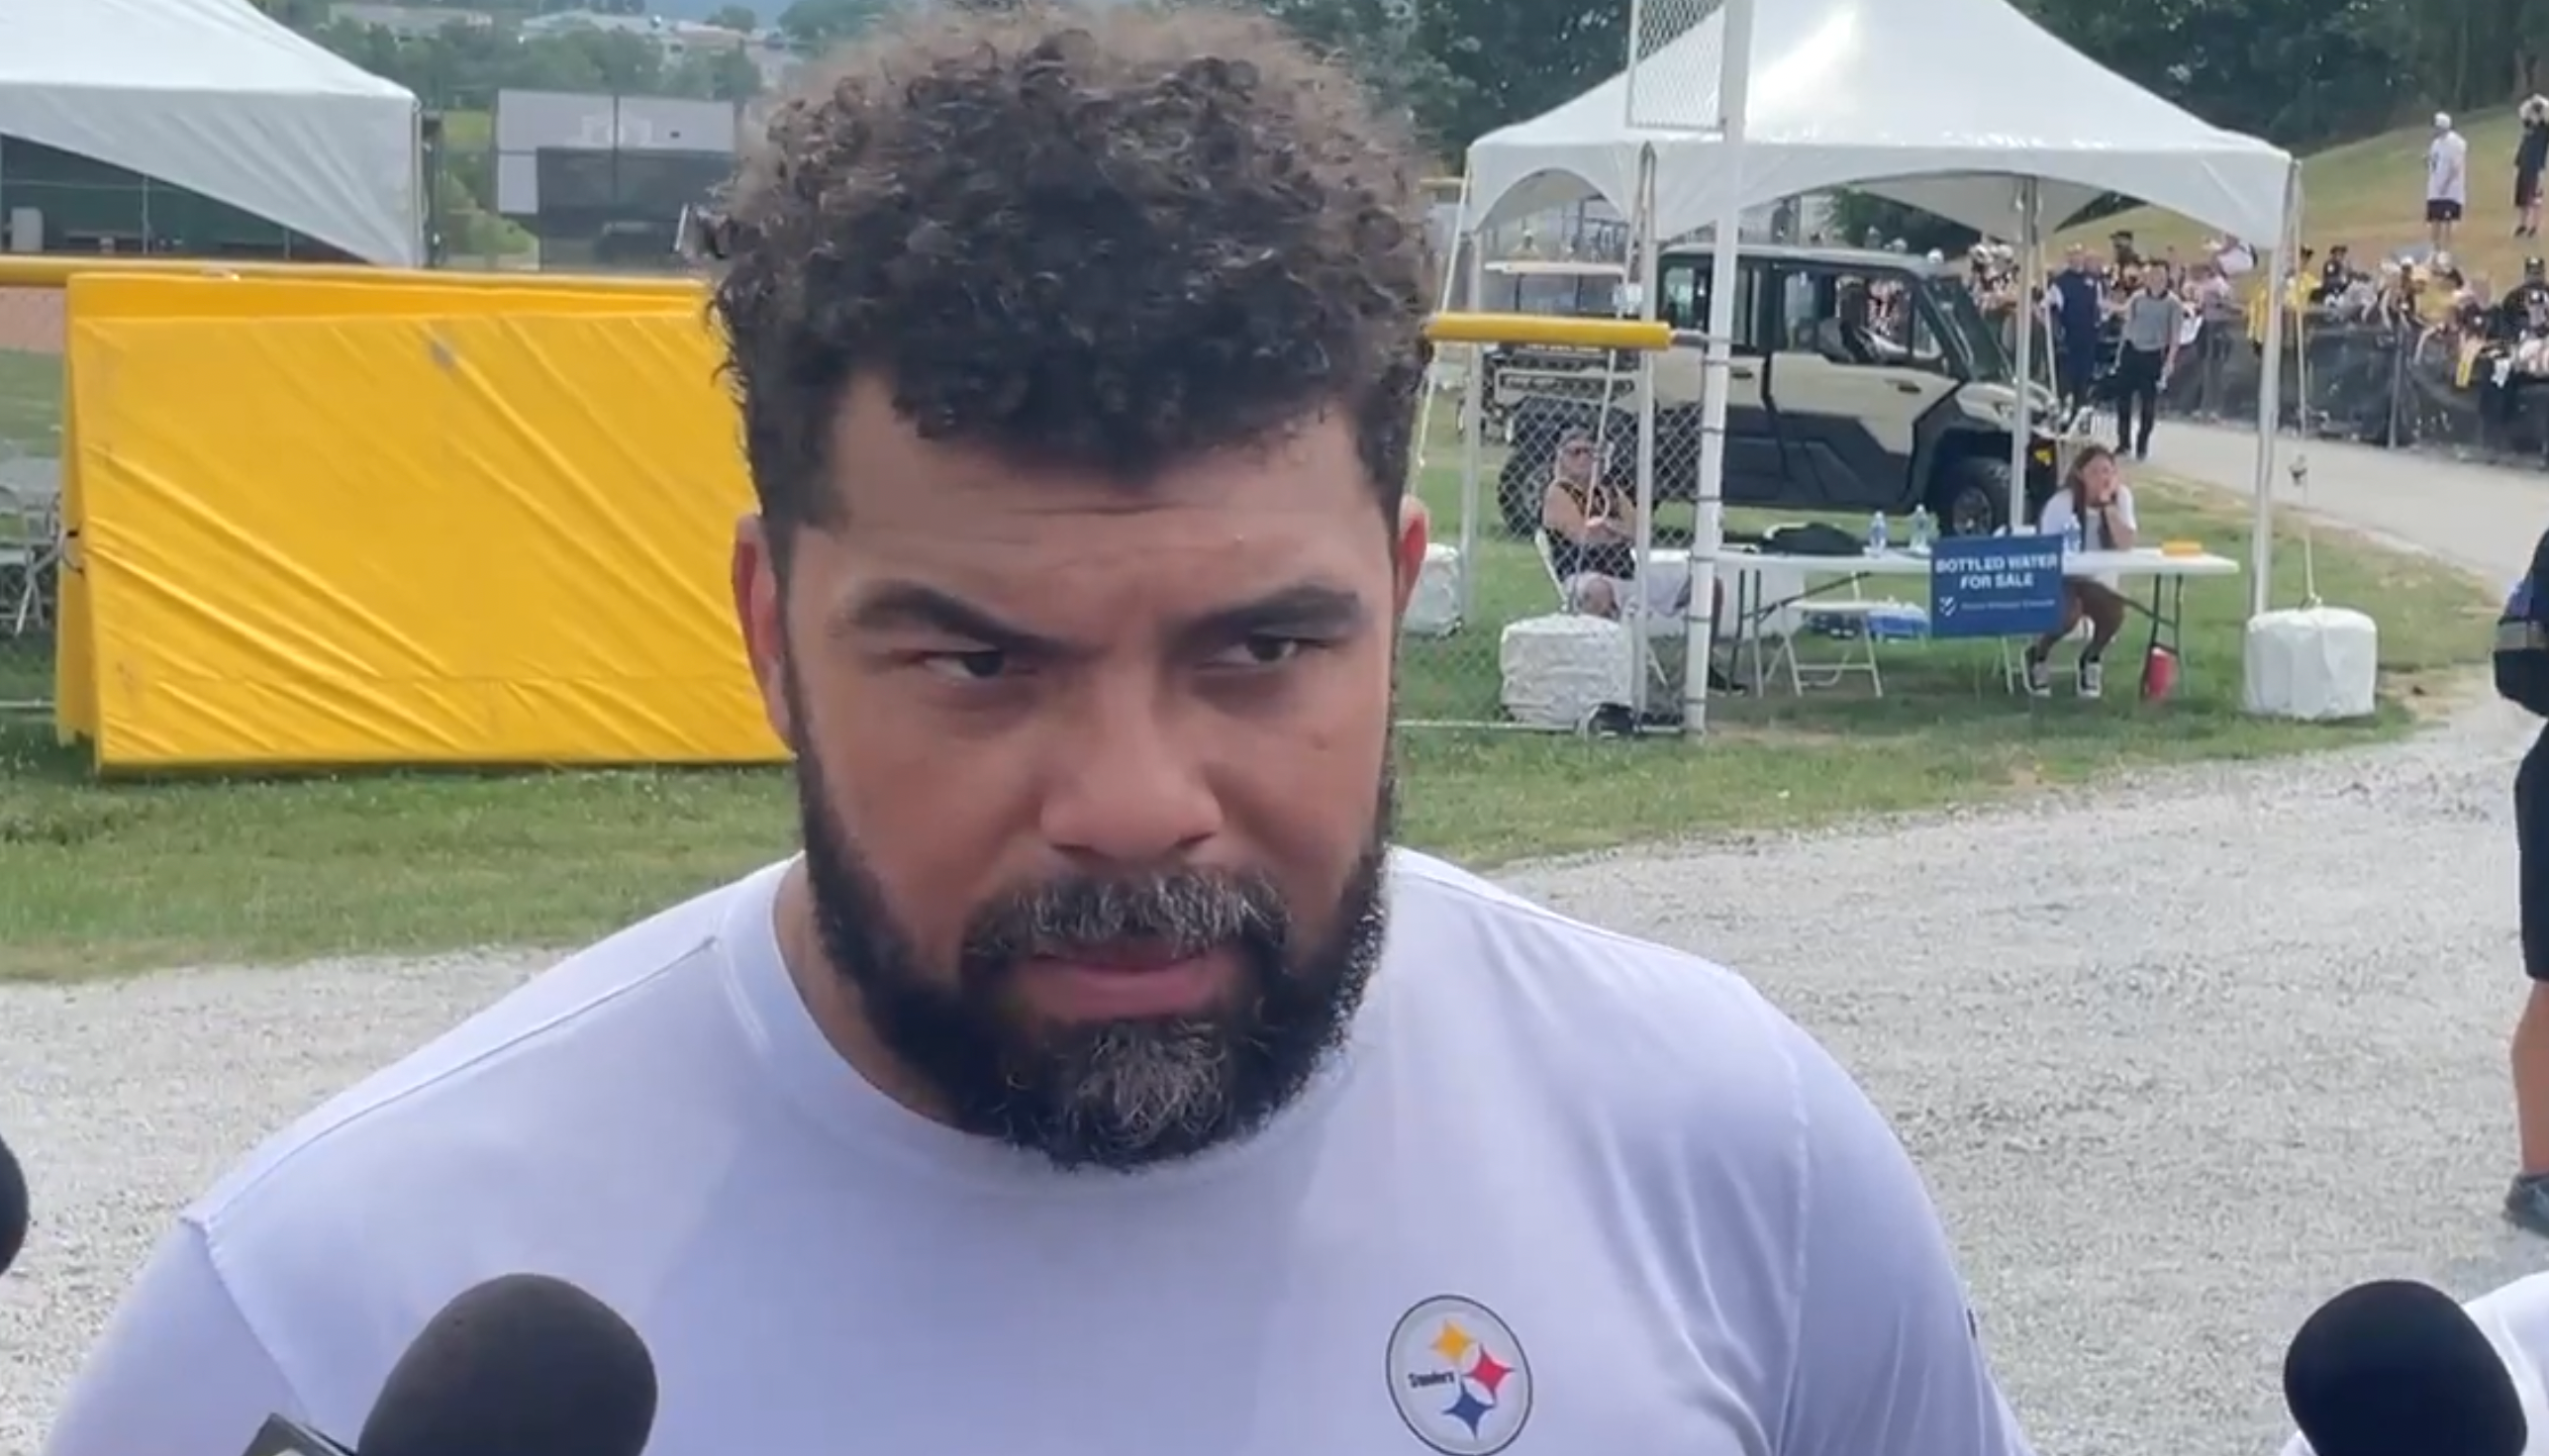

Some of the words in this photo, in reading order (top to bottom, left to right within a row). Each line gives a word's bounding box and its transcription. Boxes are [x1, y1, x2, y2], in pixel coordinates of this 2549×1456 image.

[1935, 556, 2005, 574] BOTTLED
[2008, 553, 2058, 570] WATER
[1960, 576, 1993, 590] FOR
[1995, 572, 2034, 588] SALE
